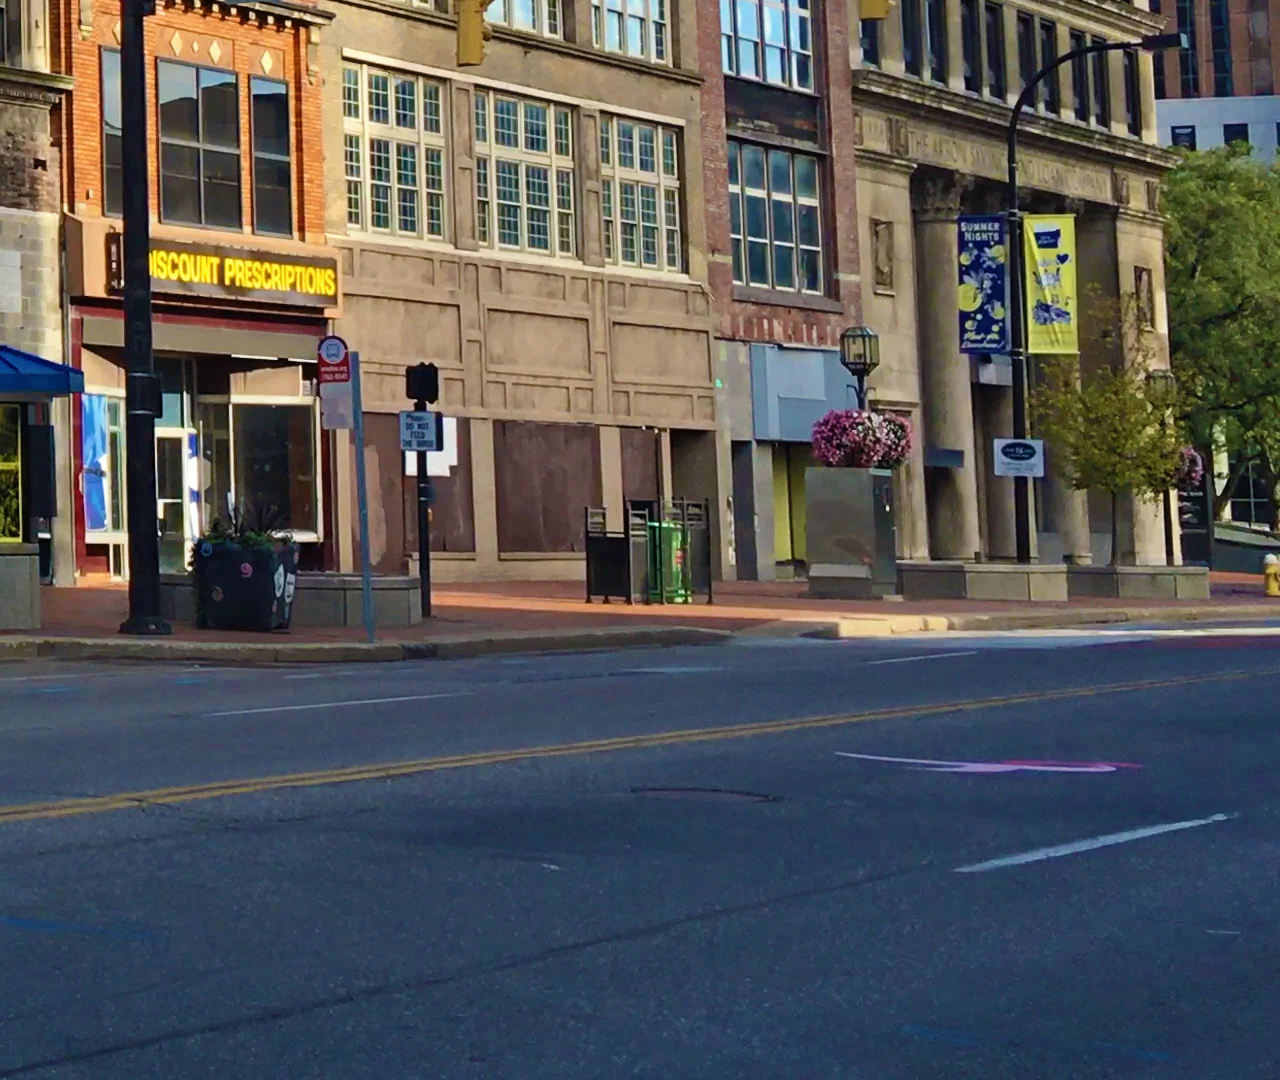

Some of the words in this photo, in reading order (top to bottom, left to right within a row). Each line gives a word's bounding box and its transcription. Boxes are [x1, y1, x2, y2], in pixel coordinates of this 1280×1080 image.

[960, 221, 1000, 232] SUMMER
[964, 231, 1000, 242] NIGHTS
[224, 258, 337, 297] PRESCRIPTIONS
